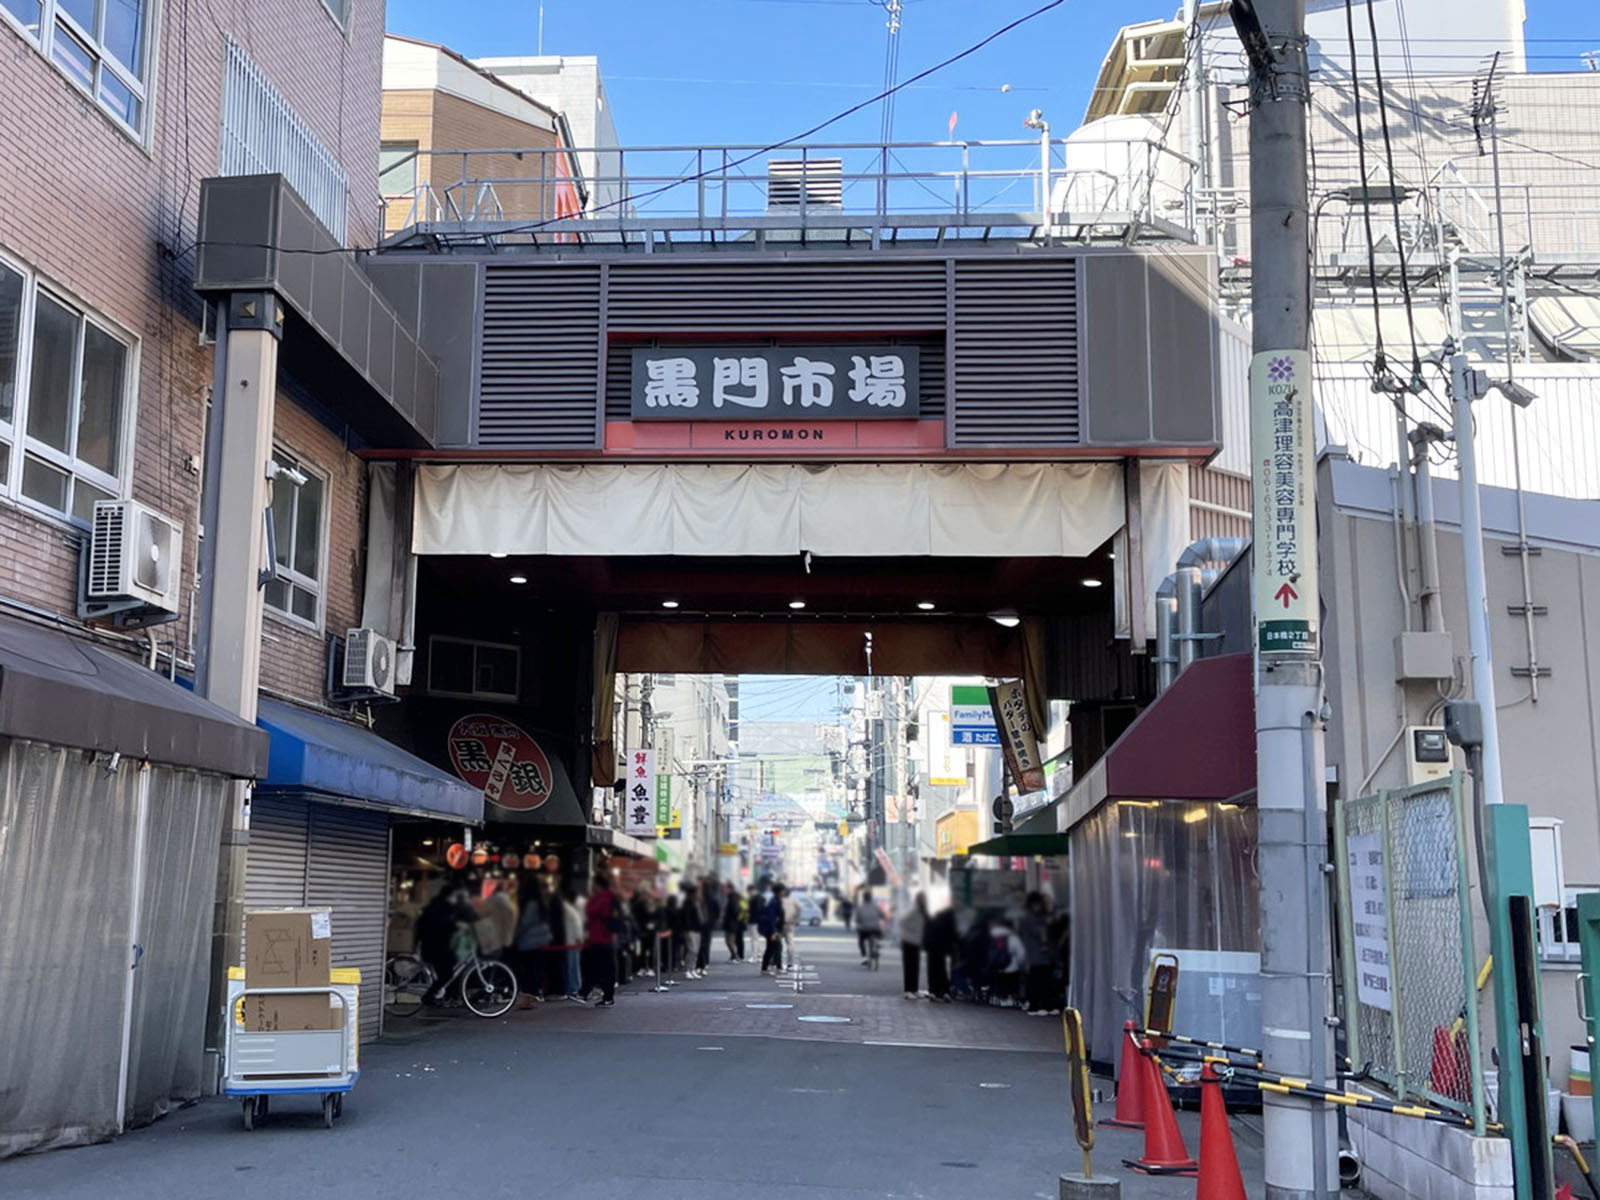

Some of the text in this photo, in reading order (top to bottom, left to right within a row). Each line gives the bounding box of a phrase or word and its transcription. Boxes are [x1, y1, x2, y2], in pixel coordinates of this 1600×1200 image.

[644, 355, 907, 408] 黒門市場
[1268, 384, 1296, 396] KOZU
[724, 429, 824, 441] KUROMON
[1273, 401, 1296, 576] 高津理容美容専門学校
[634, 752, 648, 779] 鮮魚
[630, 782, 651, 825] 魚豊
